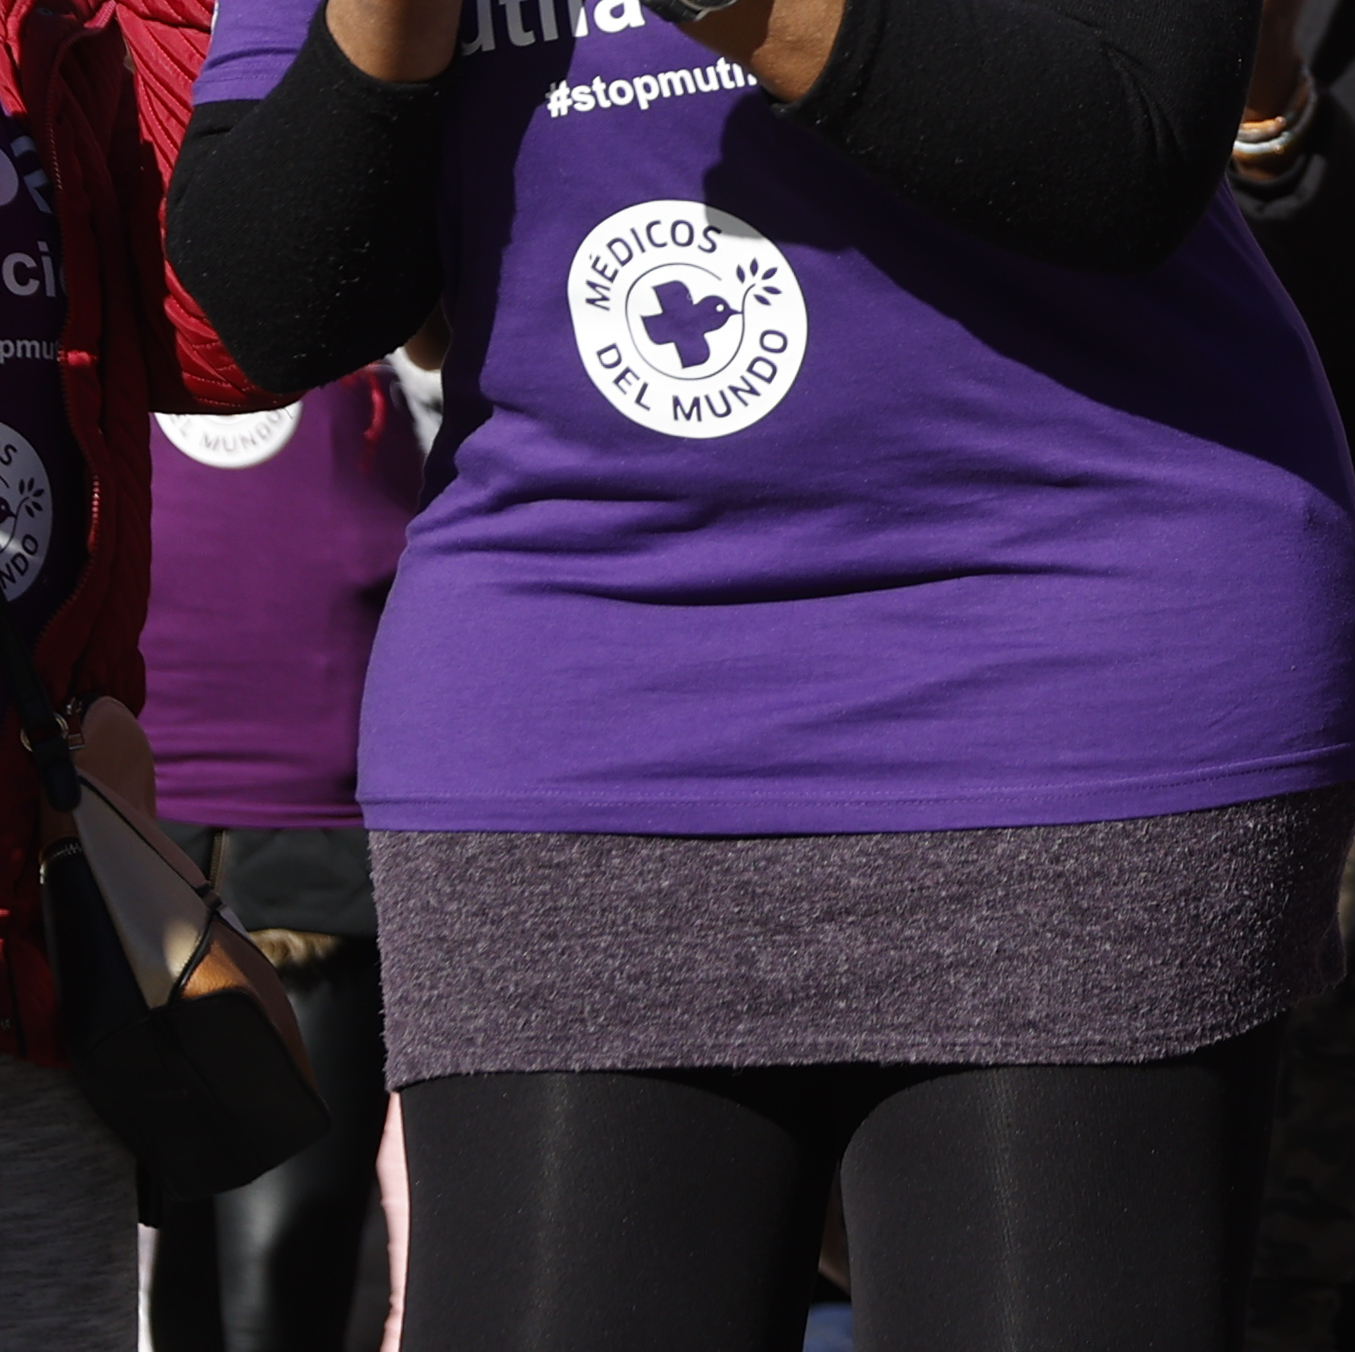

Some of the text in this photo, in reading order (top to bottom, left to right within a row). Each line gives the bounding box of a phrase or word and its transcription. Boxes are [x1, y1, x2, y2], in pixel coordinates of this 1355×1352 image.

[546, 56, 758, 119] #stopmuti
[585, 219, 722, 311] MÉDICOS
[596, 329, 788, 422] DEL MUNDO
[0, 534, 38, 590] NDO
